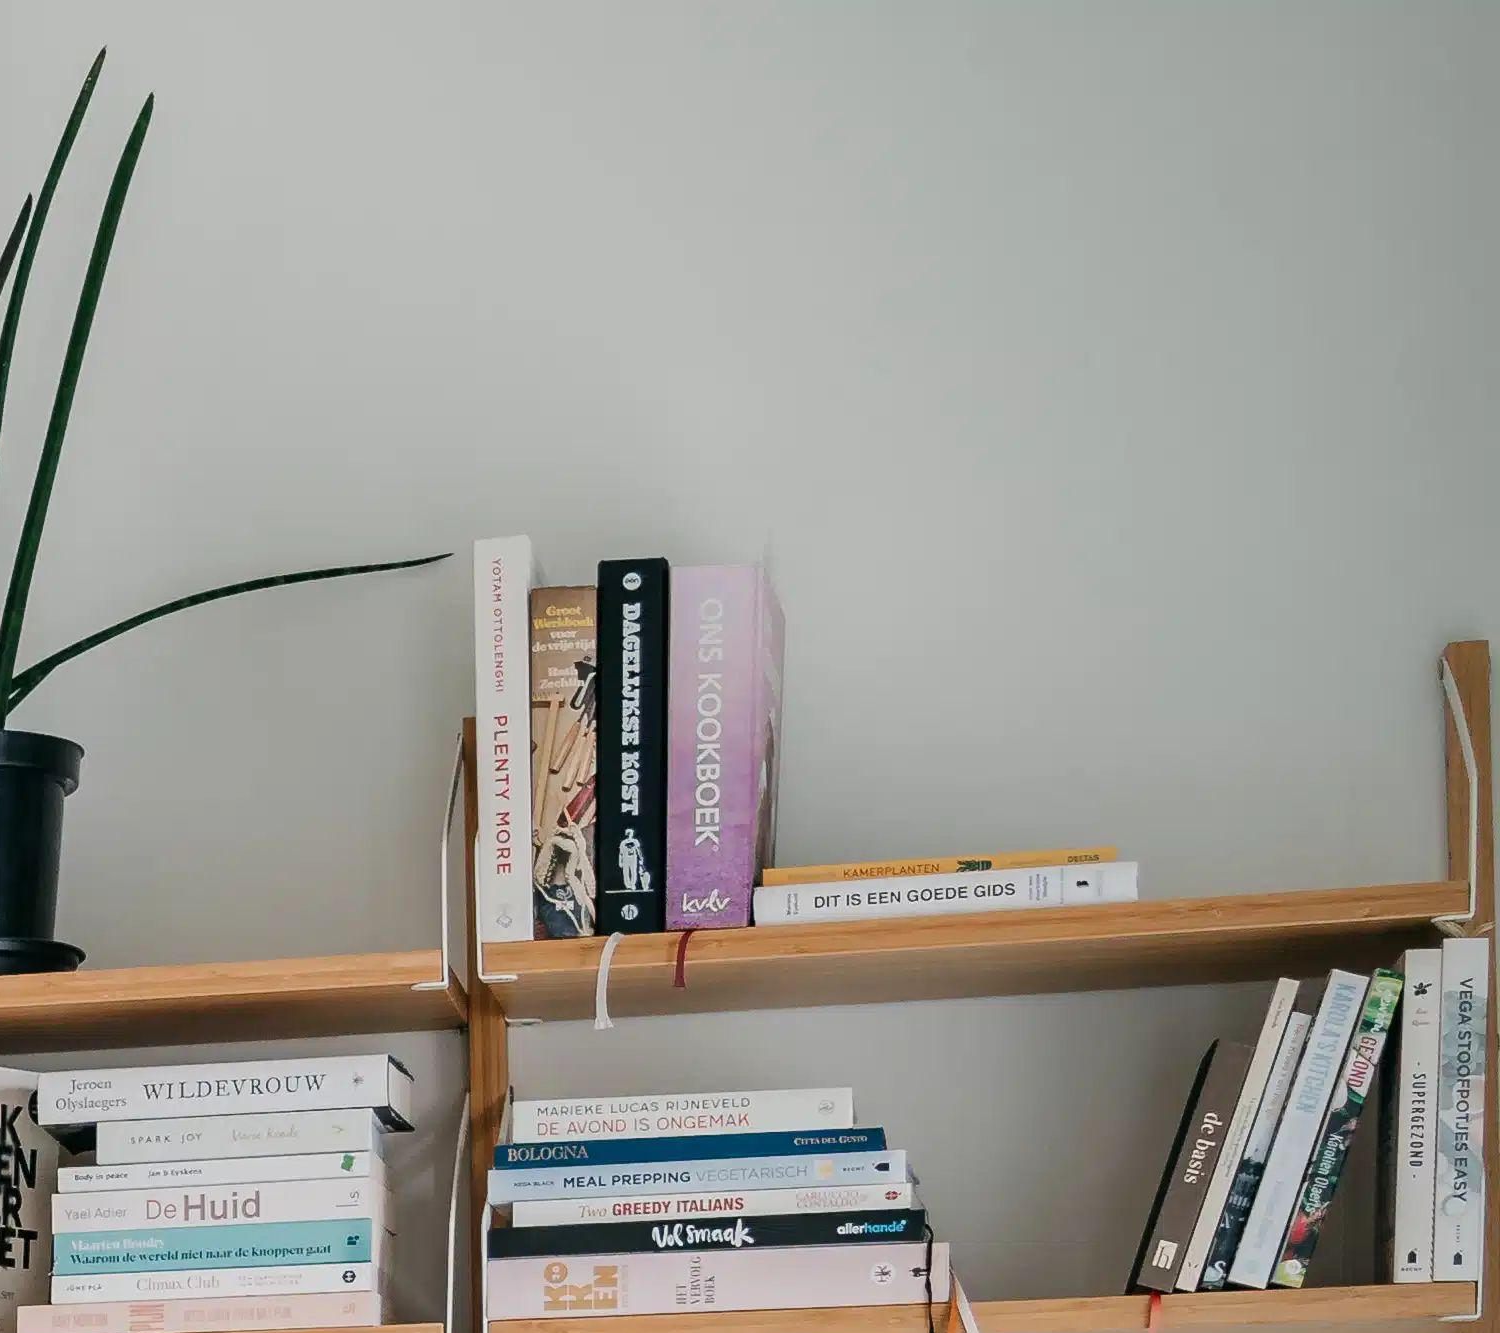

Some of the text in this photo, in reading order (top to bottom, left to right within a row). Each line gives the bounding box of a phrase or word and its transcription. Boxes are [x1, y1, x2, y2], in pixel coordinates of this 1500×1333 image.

[492, 558, 502, 602] YOTAM
[546, 605, 582, 617] Groot
[699, 599, 723, 661] ONS
[621, 603, 641, 816] DAGELIJKSE KOST
[493, 716, 512, 875] PLENTY MORE
[843, 863, 940, 879] KAMERPLANTEN
[814, 894, 841, 908] DIT
[845, 893, 861, 906] IS
[867, 890, 901, 905] EEN
[906, 886, 968, 902] GOEDE
[974, 882, 1016, 898] GIDS
[1348, 1036, 1378, 1087] GEZOND
[69, 1078, 112, 1095] Jeroen
[143, 1074, 327, 1101] WILDEVROUW
[1452, 977, 1474, 1202] VEGA STOOFPOTJES EASY
[55, 1096, 127, 1113] Olyslaegers
[537, 1097, 751, 1117] MARIEKE LUCAS RIJNEVELD
[537, 1113, 750, 1136] DE AVOND IS ONGEMAK
[1410, 1073, 1426, 1167] SUPERGEZOND
[130, 1133, 203, 1145] SPARK JOY
[1184, 1113, 1223, 1184] de basis
[507, 1145, 589, 1162] BOLOGNA
[74, 1172, 104, 1183] Body in
[563, 1165, 807, 1189] MEAL PREPPING VEGETARISCH
[65, 1208, 91, 1221] Yael
[145, 1191, 262, 1221] De Huid
[612, 1197, 745, 1217] GREEDY ITALIANS
[836, 1219, 908, 1235] allerhande
[70, 1244, 331, 1265] Waarom de wereld niet naar de knoppen gaat
[71, 1239, 120, 1251] Maarten
[187, 1275, 220, 1291] Club
